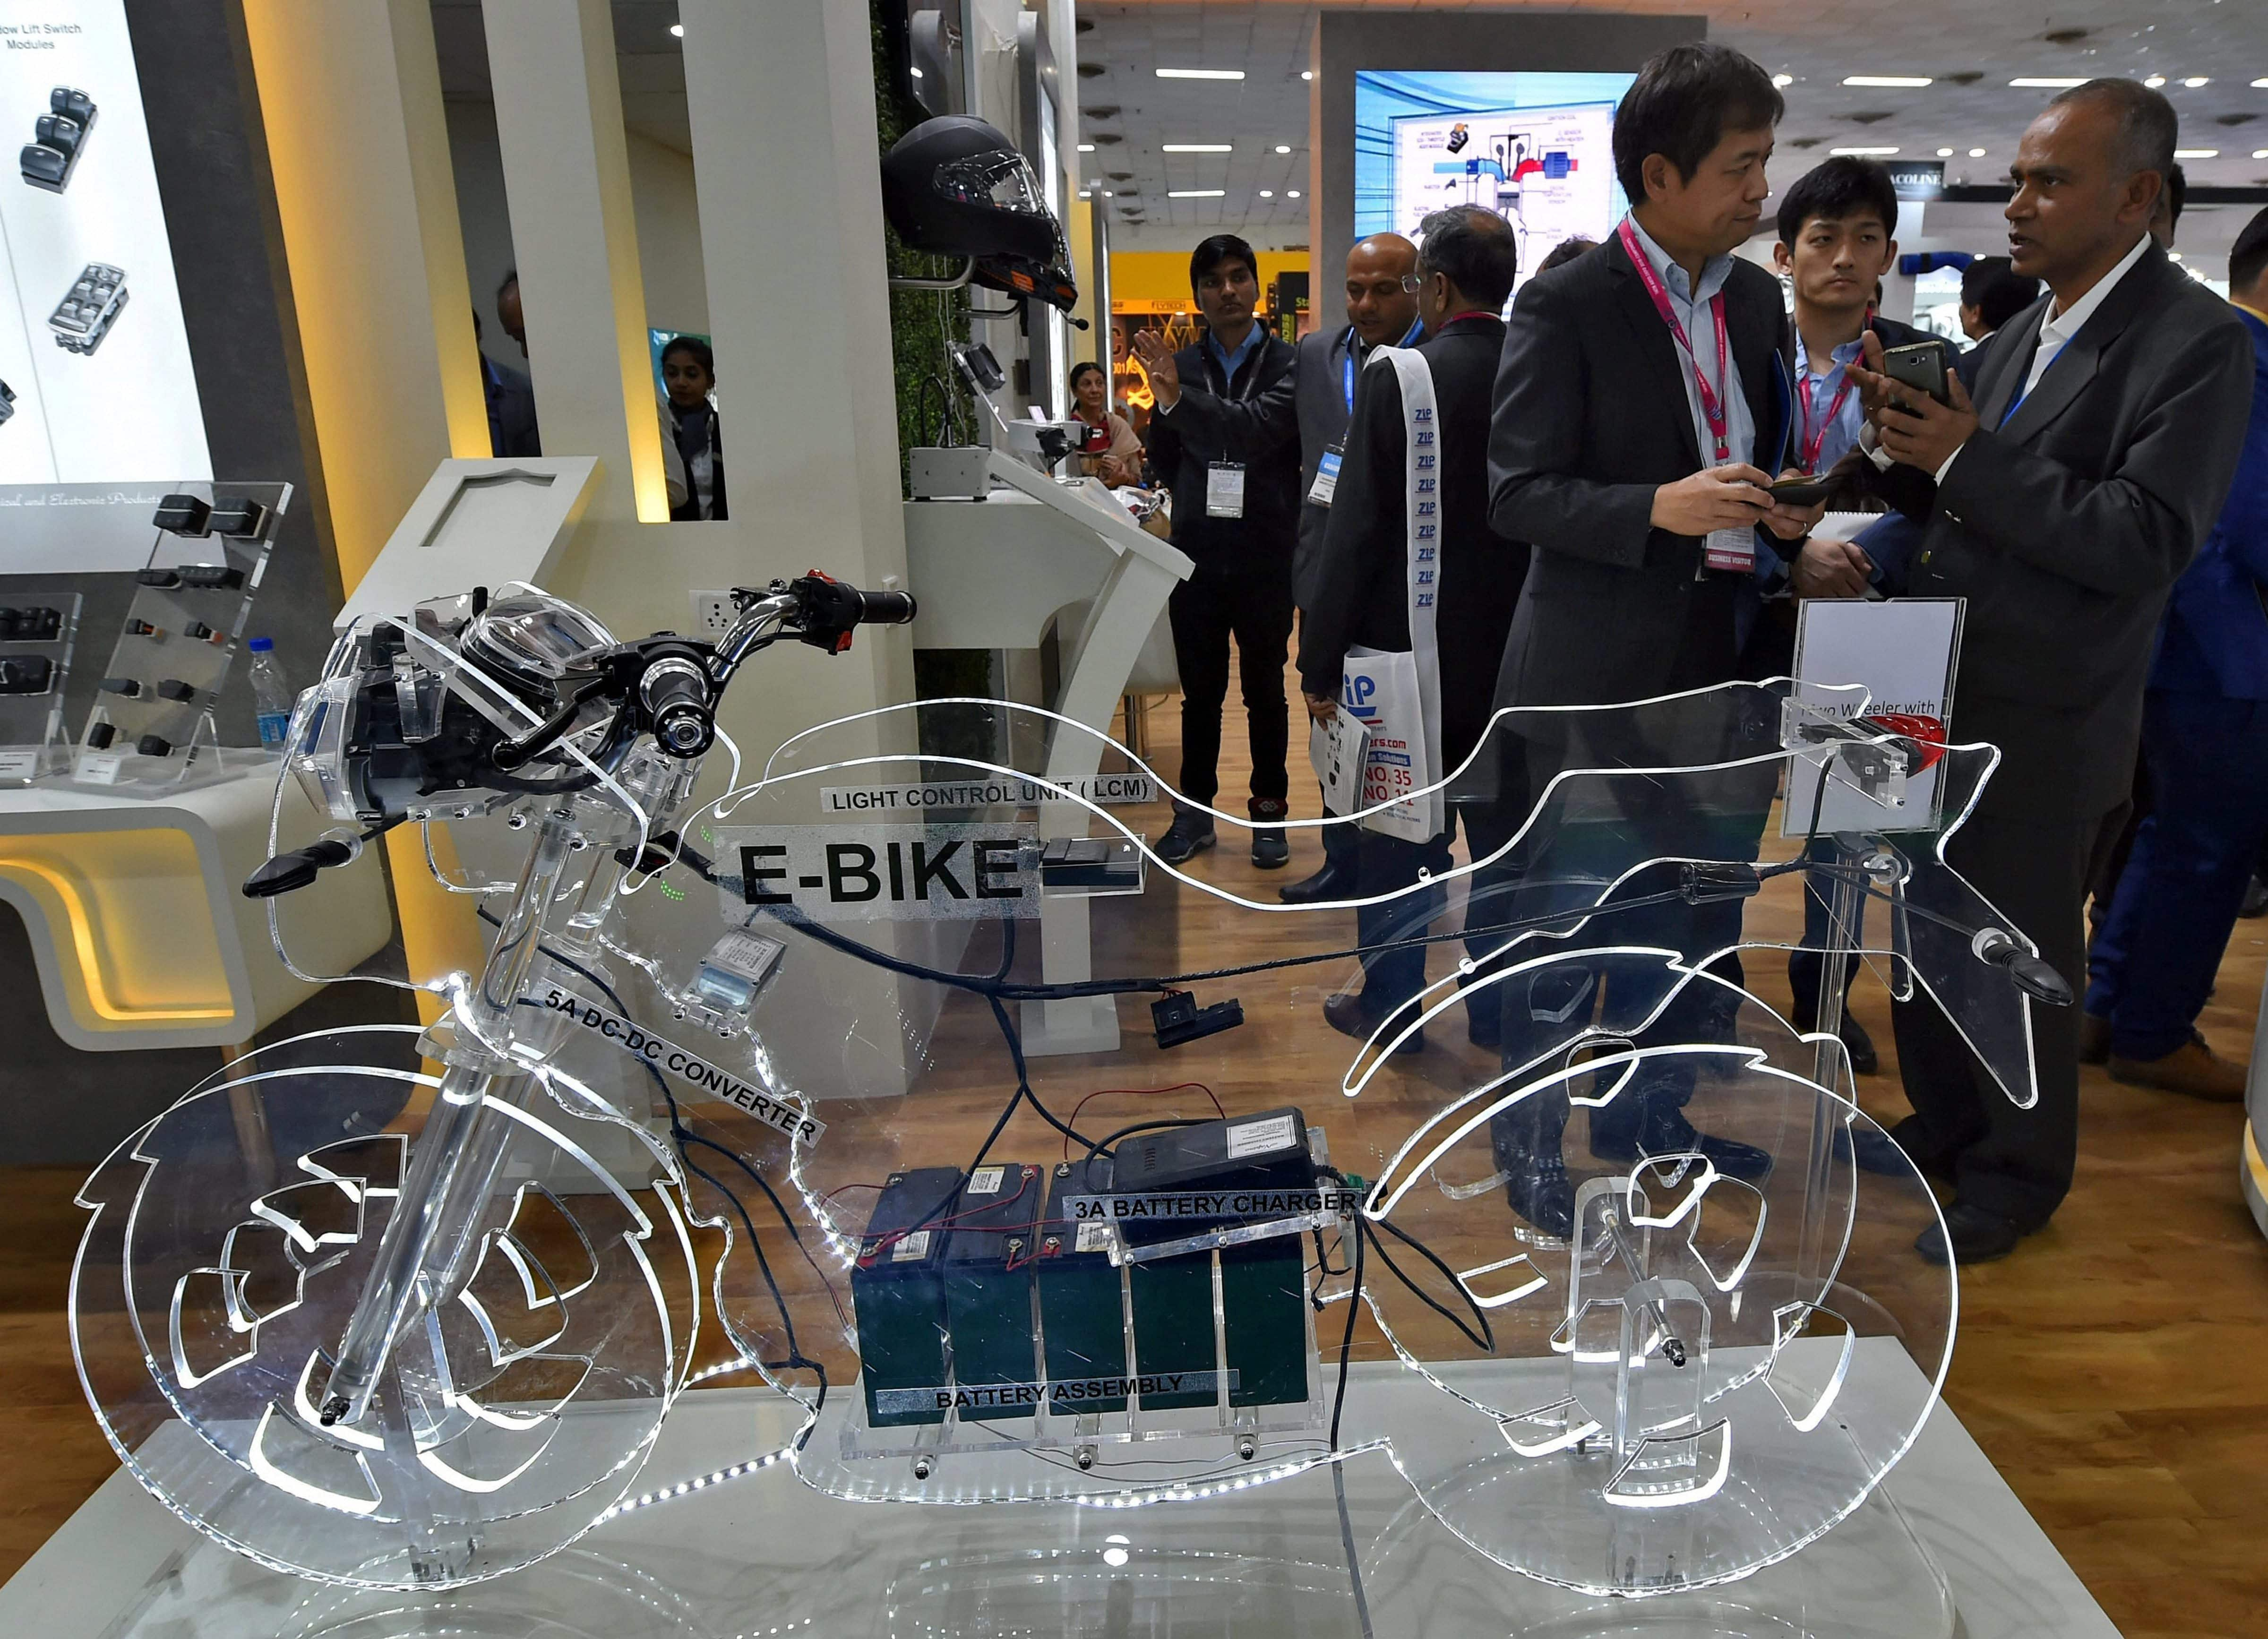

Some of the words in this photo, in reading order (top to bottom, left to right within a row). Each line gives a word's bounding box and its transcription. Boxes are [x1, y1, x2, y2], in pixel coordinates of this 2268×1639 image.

[21, 25, 41, 34] Lift
[43, 24, 82, 34] Switch
[6, 40, 55, 49] Modules
[1841, 701, 1901, 716] Weeler
[1905, 700, 1935, 714] with
[1394, 769, 1412, 786] 35
[832, 790, 898, 810] LIGHT
[906, 784, 1016, 806] CONTROL
[1022, 781, 1074, 801] UNIT
[740, 840, 1023, 904] E-BIKE
[545, 989, 576, 1019] 5A
[582, 1007, 663, 1060] DC-DC
[667, 1052, 816, 1142] CONVERTER
[1075, 1201, 1106, 1219] 3A
[1113, 1196, 1227, 1217] BATTERY
[1233, 1193, 1357, 1212] CHARGER
[936, 1386, 1046, 1409] BATTERY
[1054, 1375, 1184, 1400] ASSEMBLY
